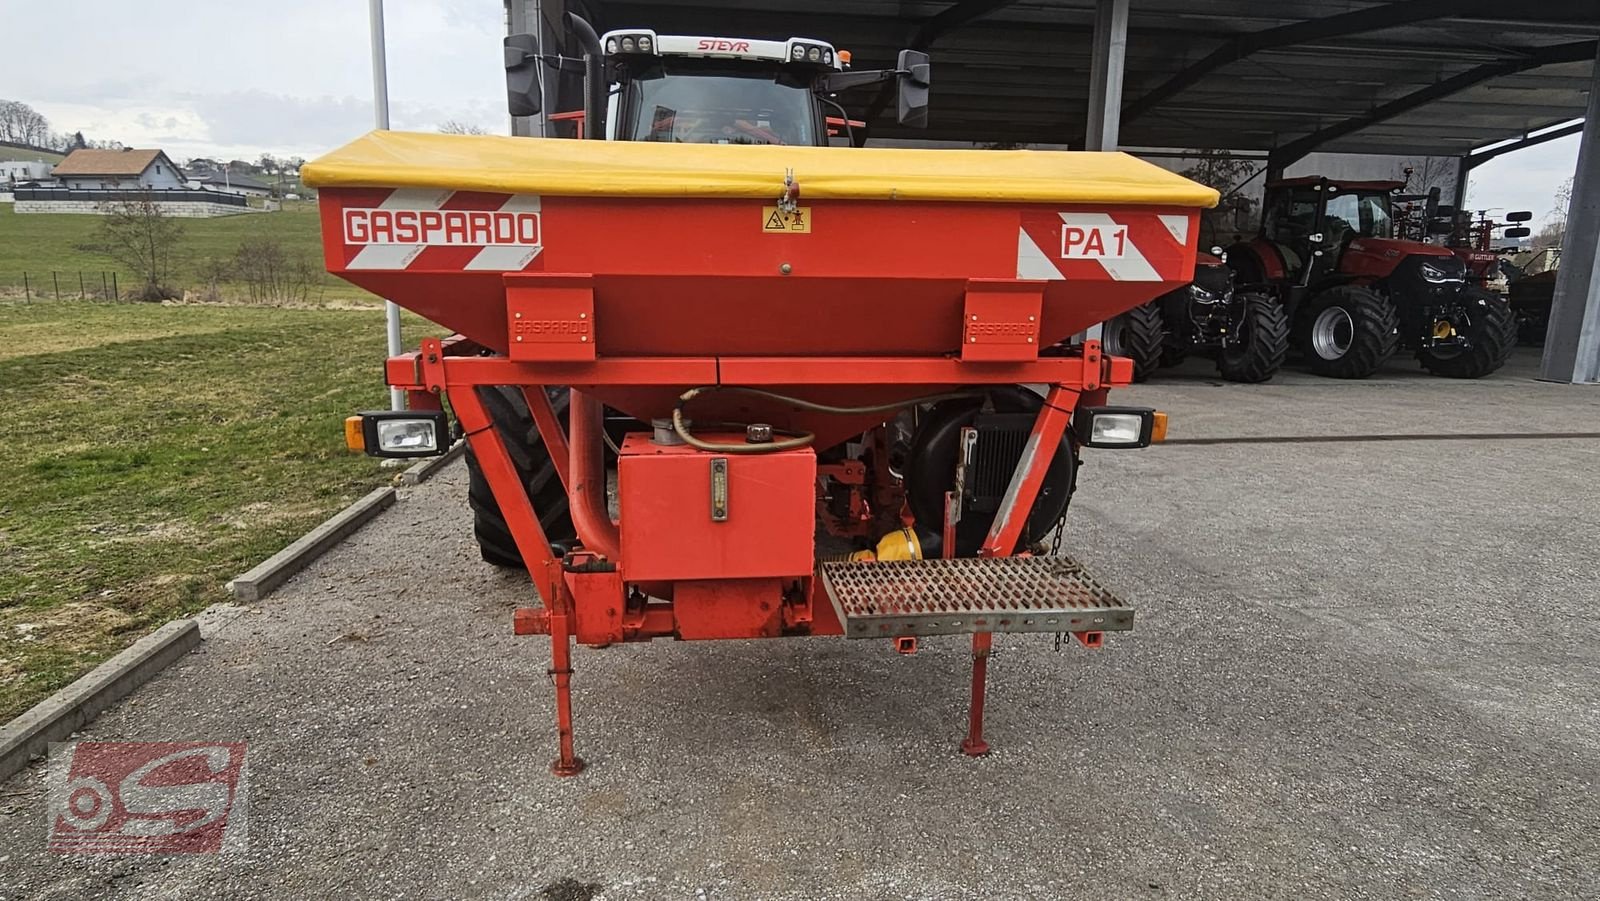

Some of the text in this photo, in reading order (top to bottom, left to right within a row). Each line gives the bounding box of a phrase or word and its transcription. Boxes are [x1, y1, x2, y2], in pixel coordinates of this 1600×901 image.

[697, 40, 749, 52] STEYR
[346, 211, 539, 244] GASPARDO
[1064, 227, 1126, 256] PA 1
[514, 320, 588, 334] GASPARDO
[969, 322, 1034, 336] GASPARDO
